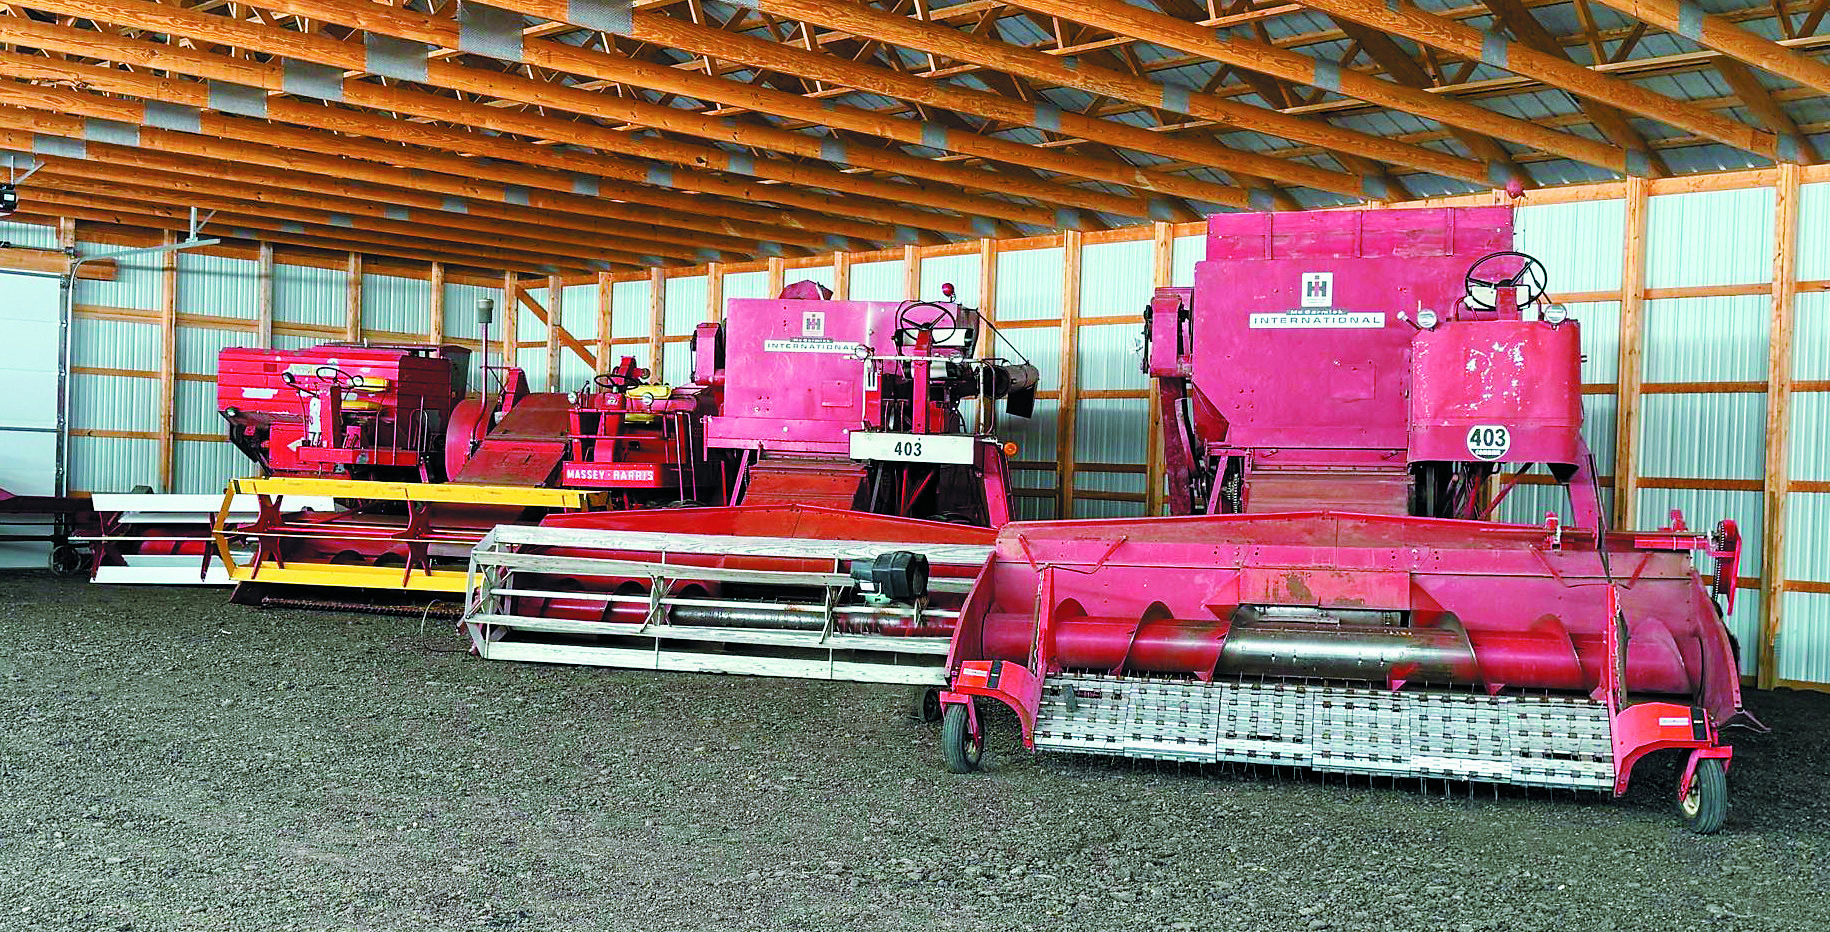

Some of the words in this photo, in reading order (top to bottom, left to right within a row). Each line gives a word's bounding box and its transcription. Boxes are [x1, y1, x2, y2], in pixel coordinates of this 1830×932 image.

[1254, 316, 1381, 324] INTERNATIONAL
[1470, 428, 1506, 447] 403
[894, 441, 922, 457] 403
